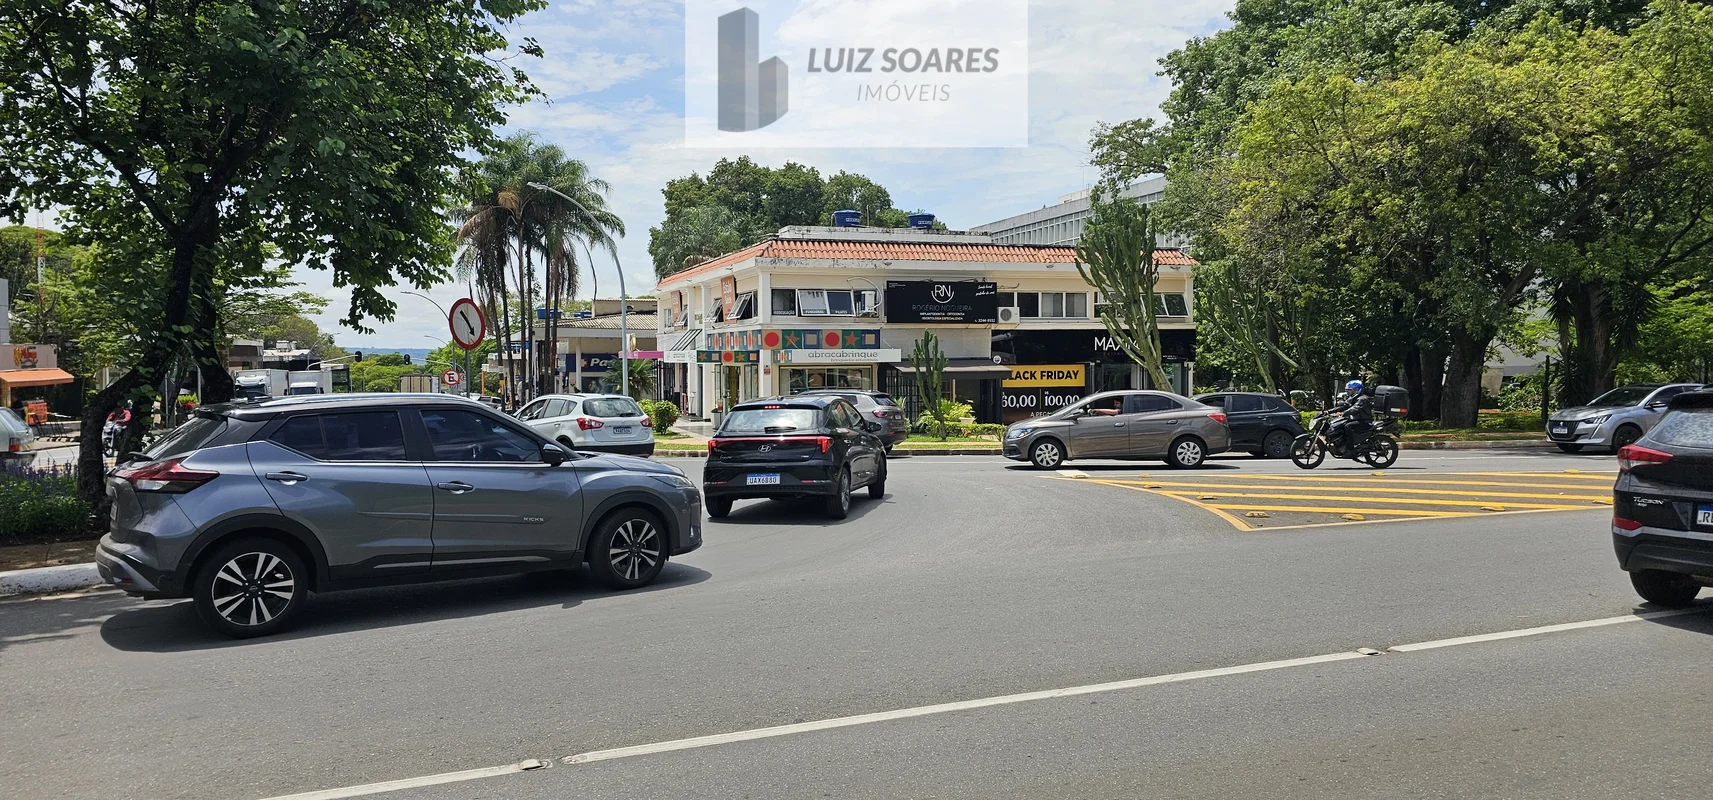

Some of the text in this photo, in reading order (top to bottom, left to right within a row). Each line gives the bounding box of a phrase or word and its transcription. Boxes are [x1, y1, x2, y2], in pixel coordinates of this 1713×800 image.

[912, 304, 973, 312] ROGÉRIO NOGUEIRA
[807, 350, 878, 359] abracabrinque
[1003, 370, 1080, 380] LACK FRIDAY
[1633, 496, 1664, 505] TUCSON
